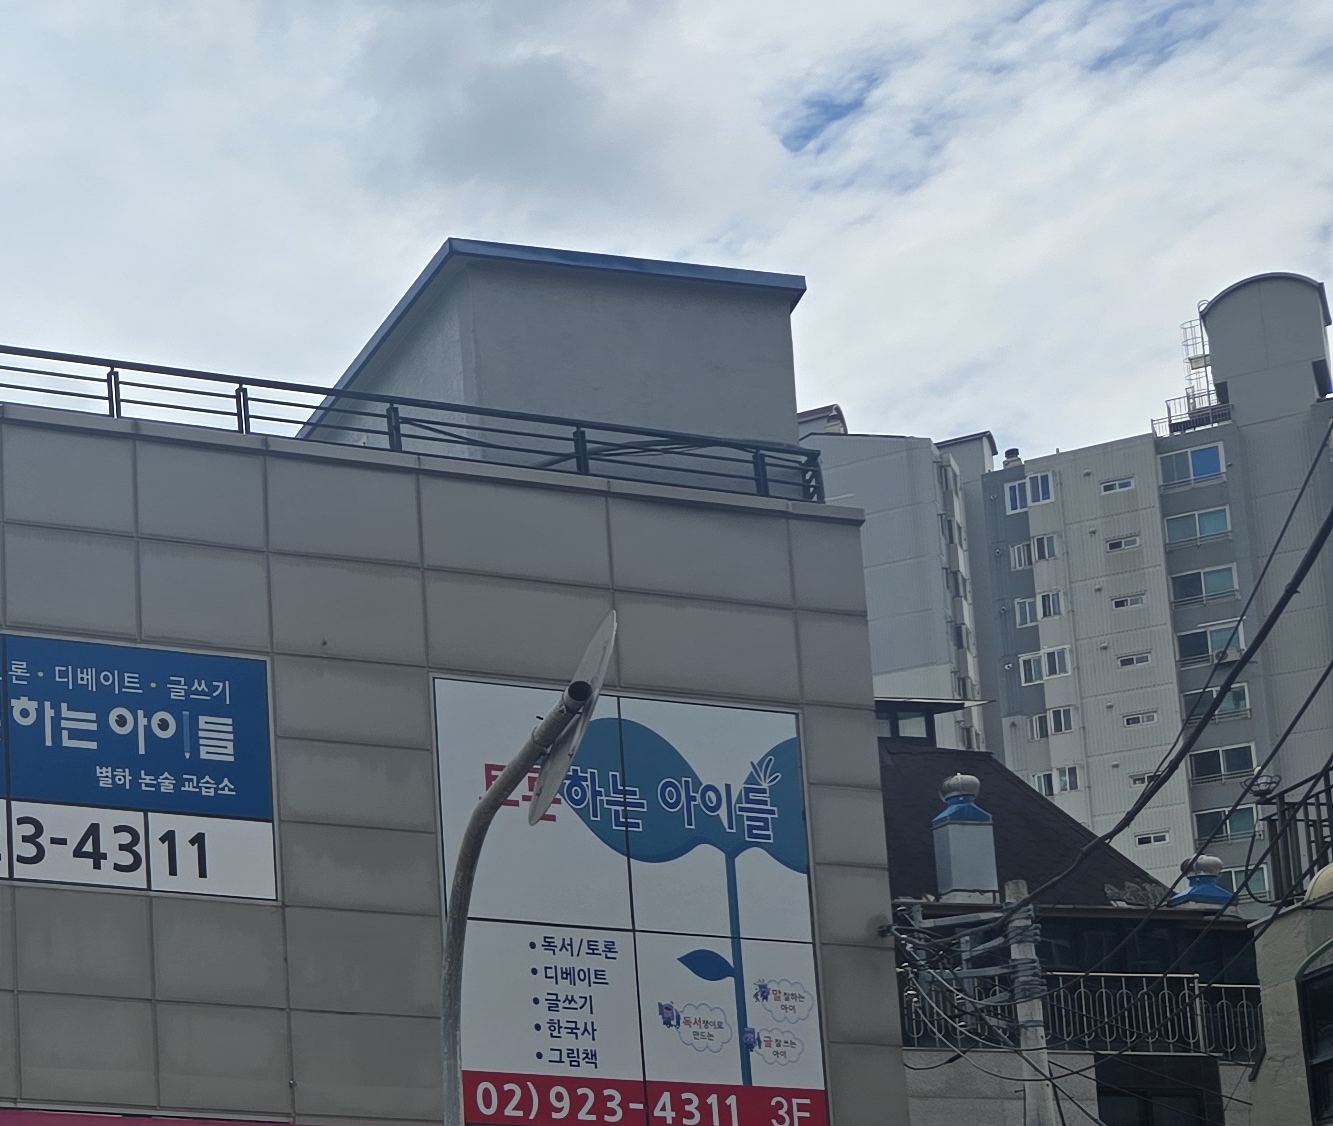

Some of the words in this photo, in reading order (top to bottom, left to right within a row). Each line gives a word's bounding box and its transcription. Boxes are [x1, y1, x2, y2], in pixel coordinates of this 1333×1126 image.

[54, 665, 143, 694] 디베이트
[166, 676, 231, 704] 글쓰기
[96, 766, 132, 789] 별하
[139, 770, 176, 793] 논술
[182, 774, 236, 795] 교습소
[659, 777, 777, 843] 아이들
[541, 936, 618, 960] 독서/토론
[544, 966, 609, 986] 디베이트
[546, 993, 594, 1014] 글쓰기
[547, 1021, 597, 1041] 한국사
[549, 1049, 598, 1069] 그림책
[477, 1081, 738, 1126] 02)923-4311
